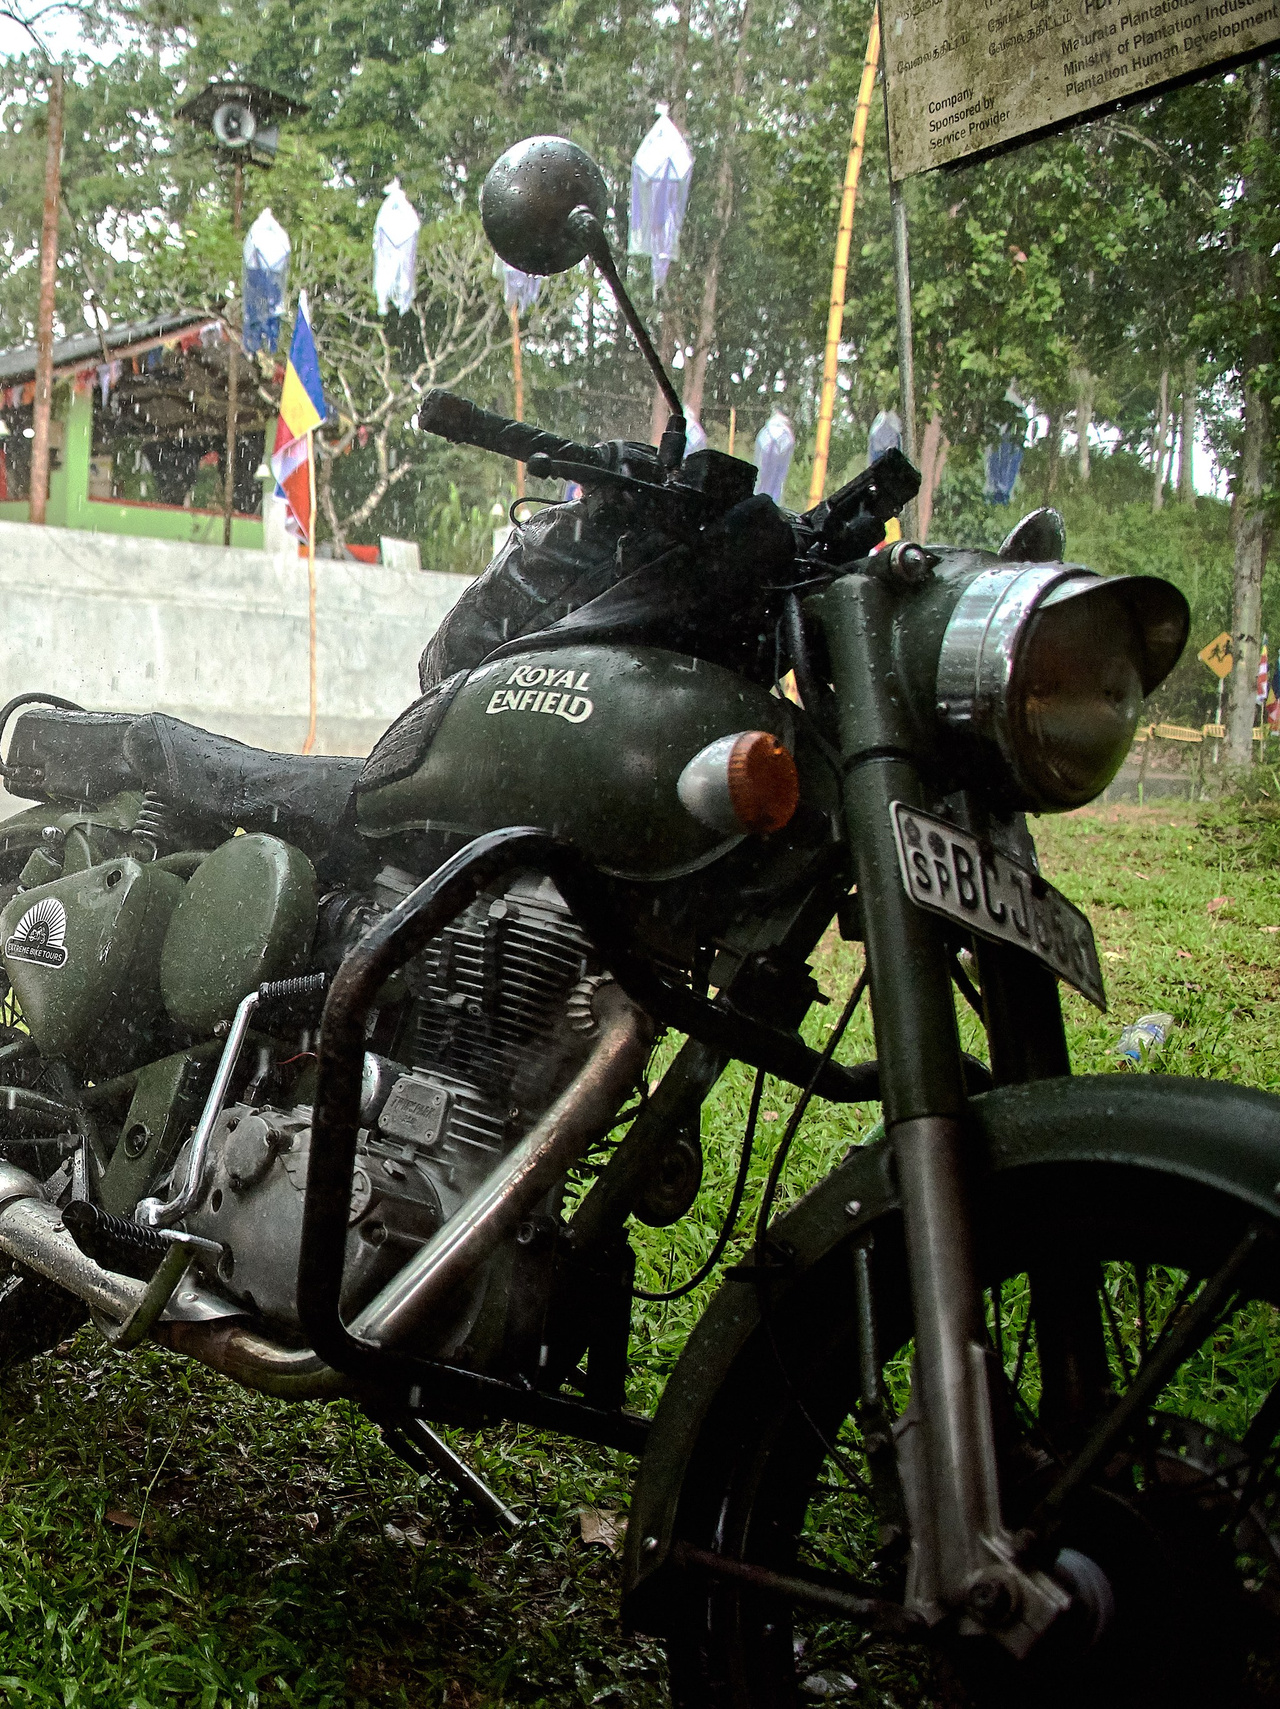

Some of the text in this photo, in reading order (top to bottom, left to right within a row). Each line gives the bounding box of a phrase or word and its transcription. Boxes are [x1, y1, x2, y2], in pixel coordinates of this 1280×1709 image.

[1063, 47, 1111, 77] Ministry
[1117, 38, 1130, 55] of
[1133, 14, 1201, 49] Plantation
[1066, 4, 1279, 97] Plantation Human Development
[928, 87, 974, 114] Company
[929, 95, 995, 133] Sponsored by
[929, 110, 1010, 150] Service Provider
[506, 665, 591, 692] ROYAL
[485, 689, 594, 724] ENFIELD
[910, 851, 951, 897] SP
[8, 943, 62, 961] EXTREME BIKE TOURS
